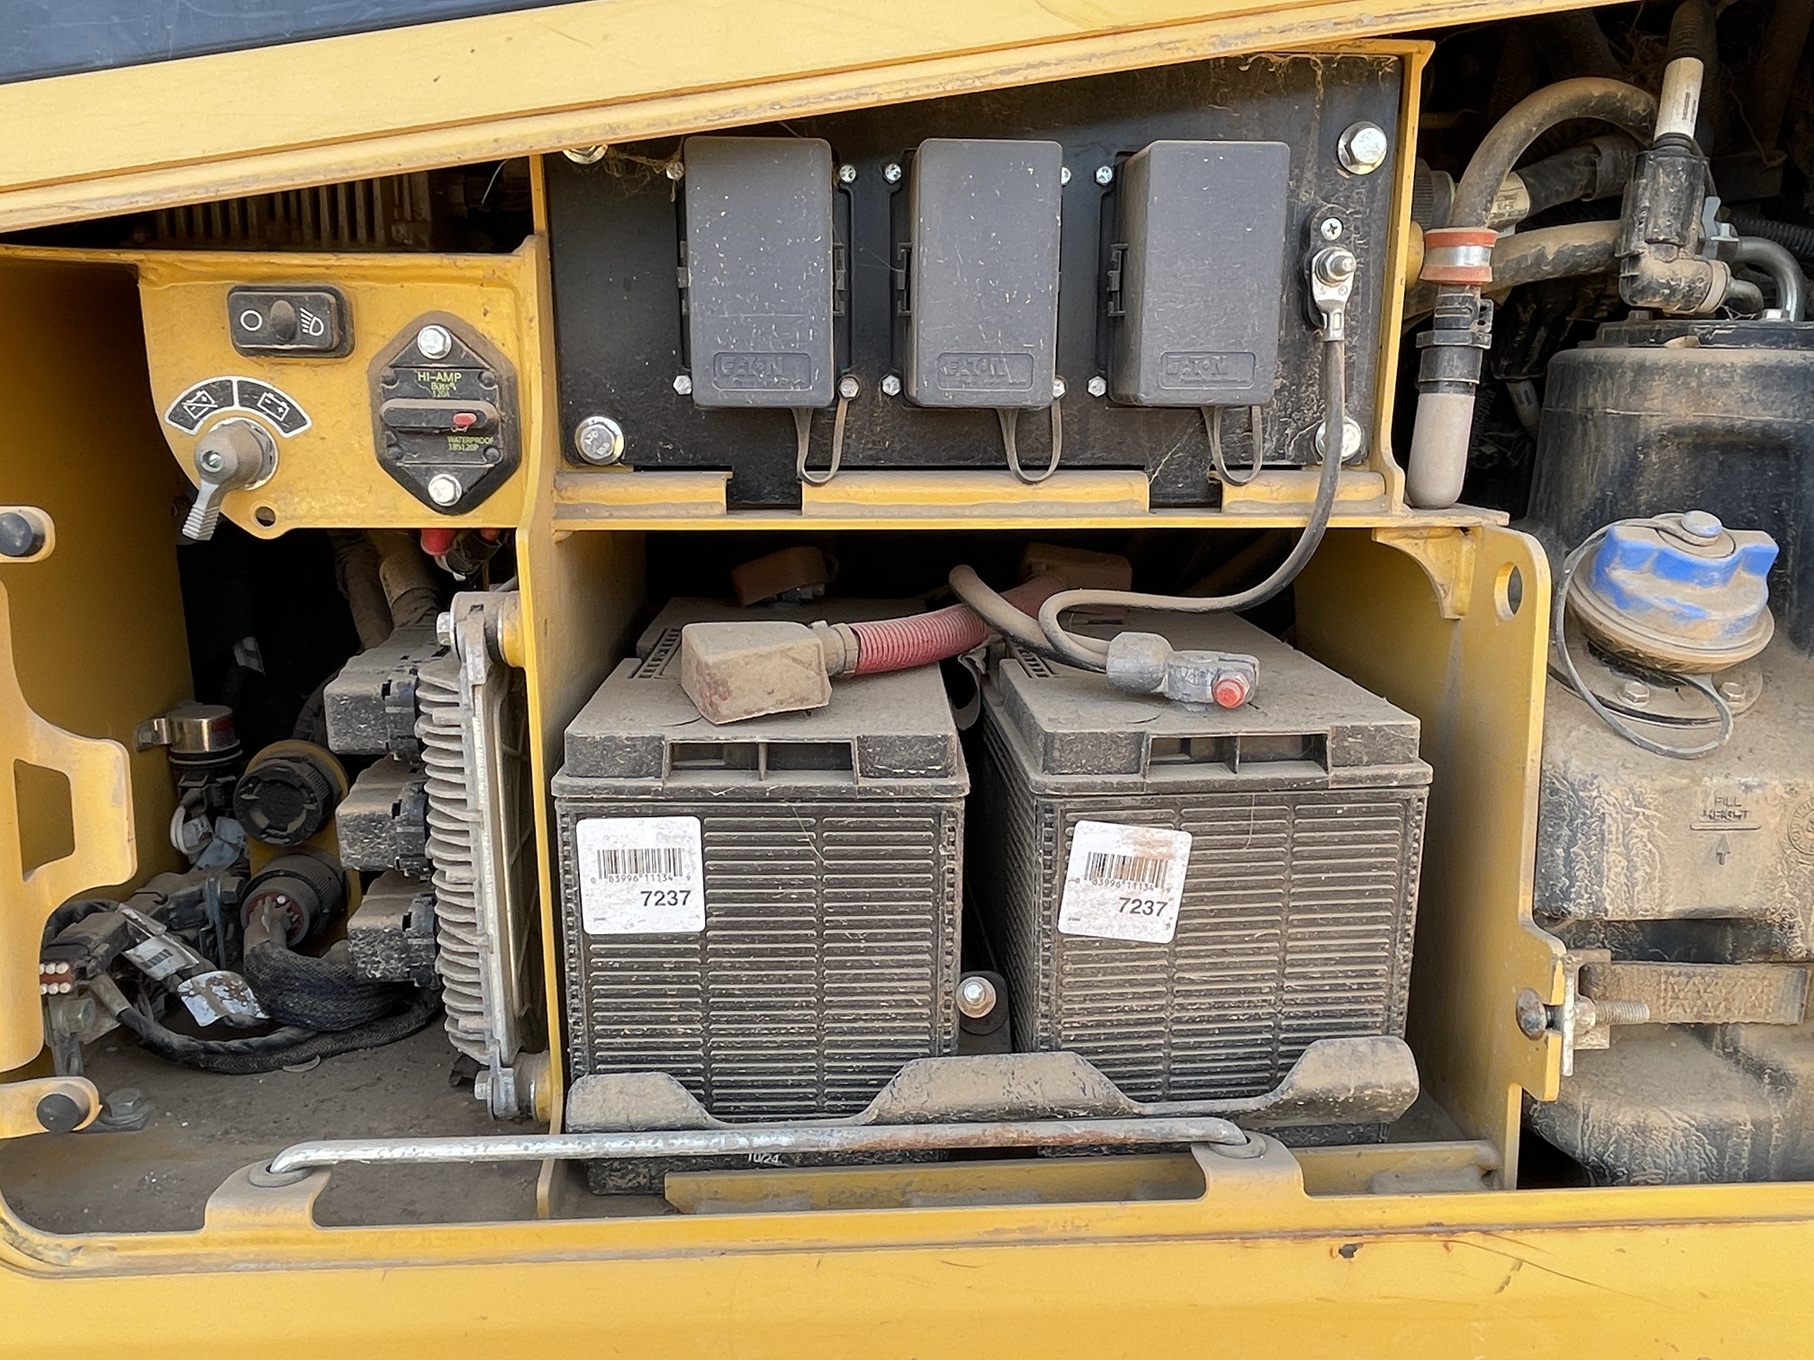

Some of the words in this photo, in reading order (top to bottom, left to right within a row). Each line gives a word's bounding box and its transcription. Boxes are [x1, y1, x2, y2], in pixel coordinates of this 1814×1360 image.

[417, 371, 462, 382] HI-AMP
[447, 436, 494, 445] WATERPROOF
[1713, 795, 1743, 808] FILL
[608, 874, 639, 883] 83996
[640, 890, 691, 907] 7237
[1118, 897, 1169, 917] 7237
